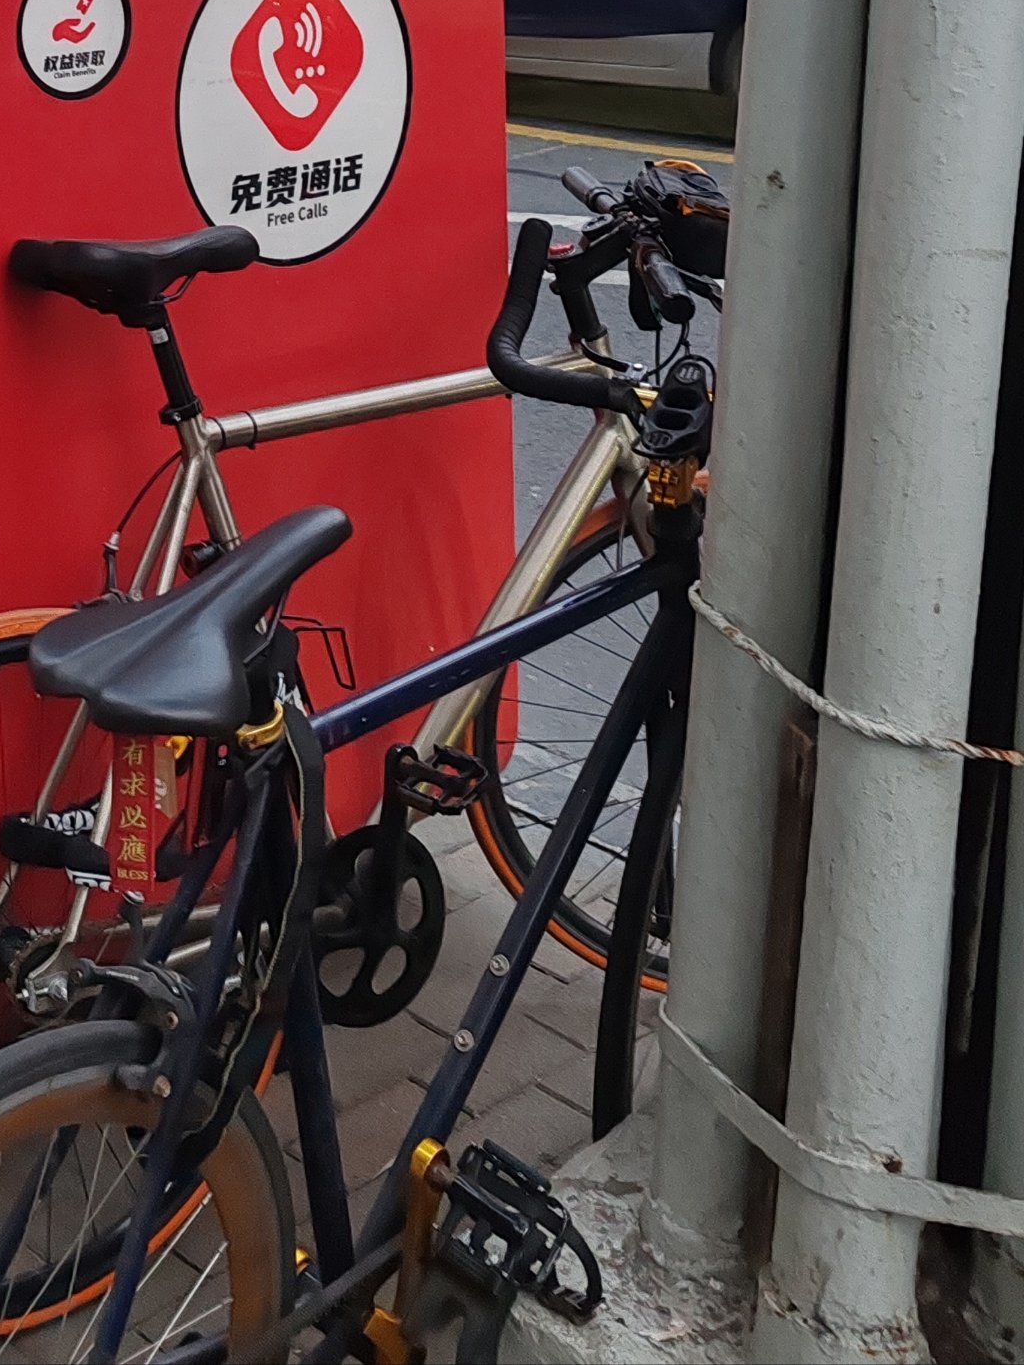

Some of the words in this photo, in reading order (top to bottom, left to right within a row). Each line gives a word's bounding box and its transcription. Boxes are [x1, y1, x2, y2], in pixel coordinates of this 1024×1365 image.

[44, 50, 106, 72] 权益领取
[72, 67, 96, 76] Benefits
[229, 154, 363, 214] 免费通话
[267, 212, 295, 227] Free
[298, 203, 328, 221] Calls
[117, 739, 149, 863] 有求必應
